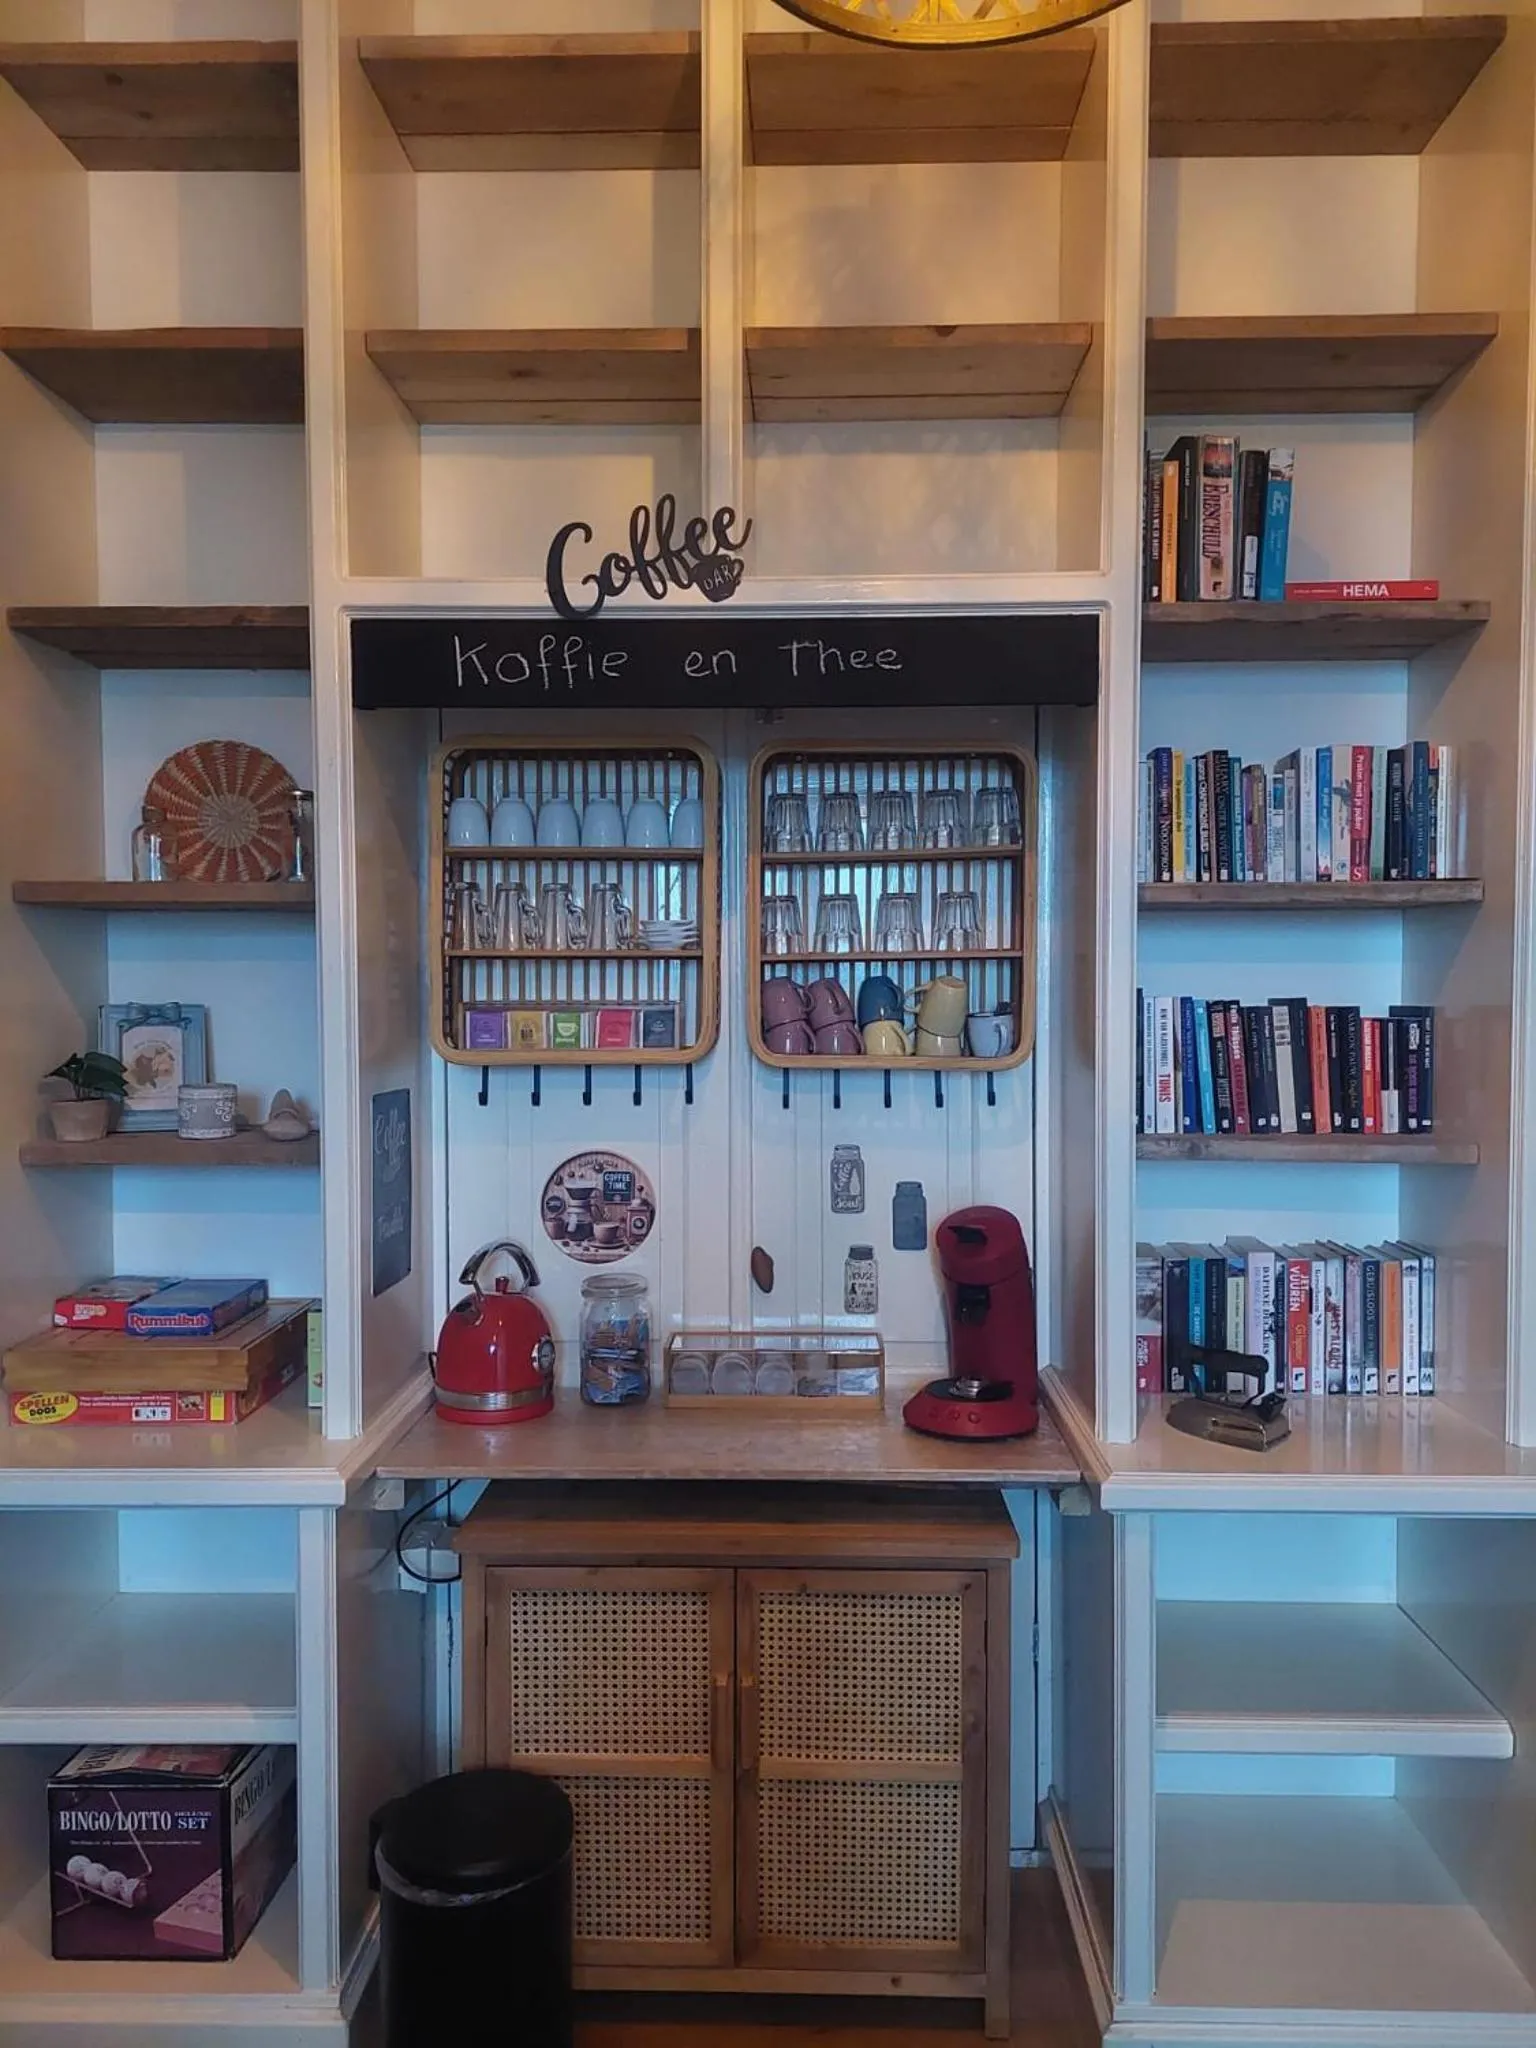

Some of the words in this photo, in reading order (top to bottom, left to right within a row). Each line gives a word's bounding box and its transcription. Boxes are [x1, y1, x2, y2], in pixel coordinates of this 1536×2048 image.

[1203, 482, 1229, 560] ERESCHULD
[546, 493, 752, 620] Coffee
[1343, 584, 1390, 597] HEMA
[454, 635, 630, 690] Koffie
[685, 644, 737, 677] en
[779, 638, 904, 677] Thee
[1355, 782, 1364, 797] met
[1354, 798, 1363, 806] je
[1158, 1073, 1171, 1103] TUNIS
[604, 1173, 631, 1182] COFFEE
[608, 1182, 627, 1190] TIME
[1262, 1266, 1271, 1307] DAPHNE
[1290, 1265, 1300, 1312] VUUREN
[1300, 1274, 1309, 1289] JET
[19, 1393, 70, 1410] SPELLEN
[29, 1406, 57, 1417] DOOS
[60, 1811, 172, 1831] BINGO/LOTTO
[178, 1817, 208, 1829] SET
